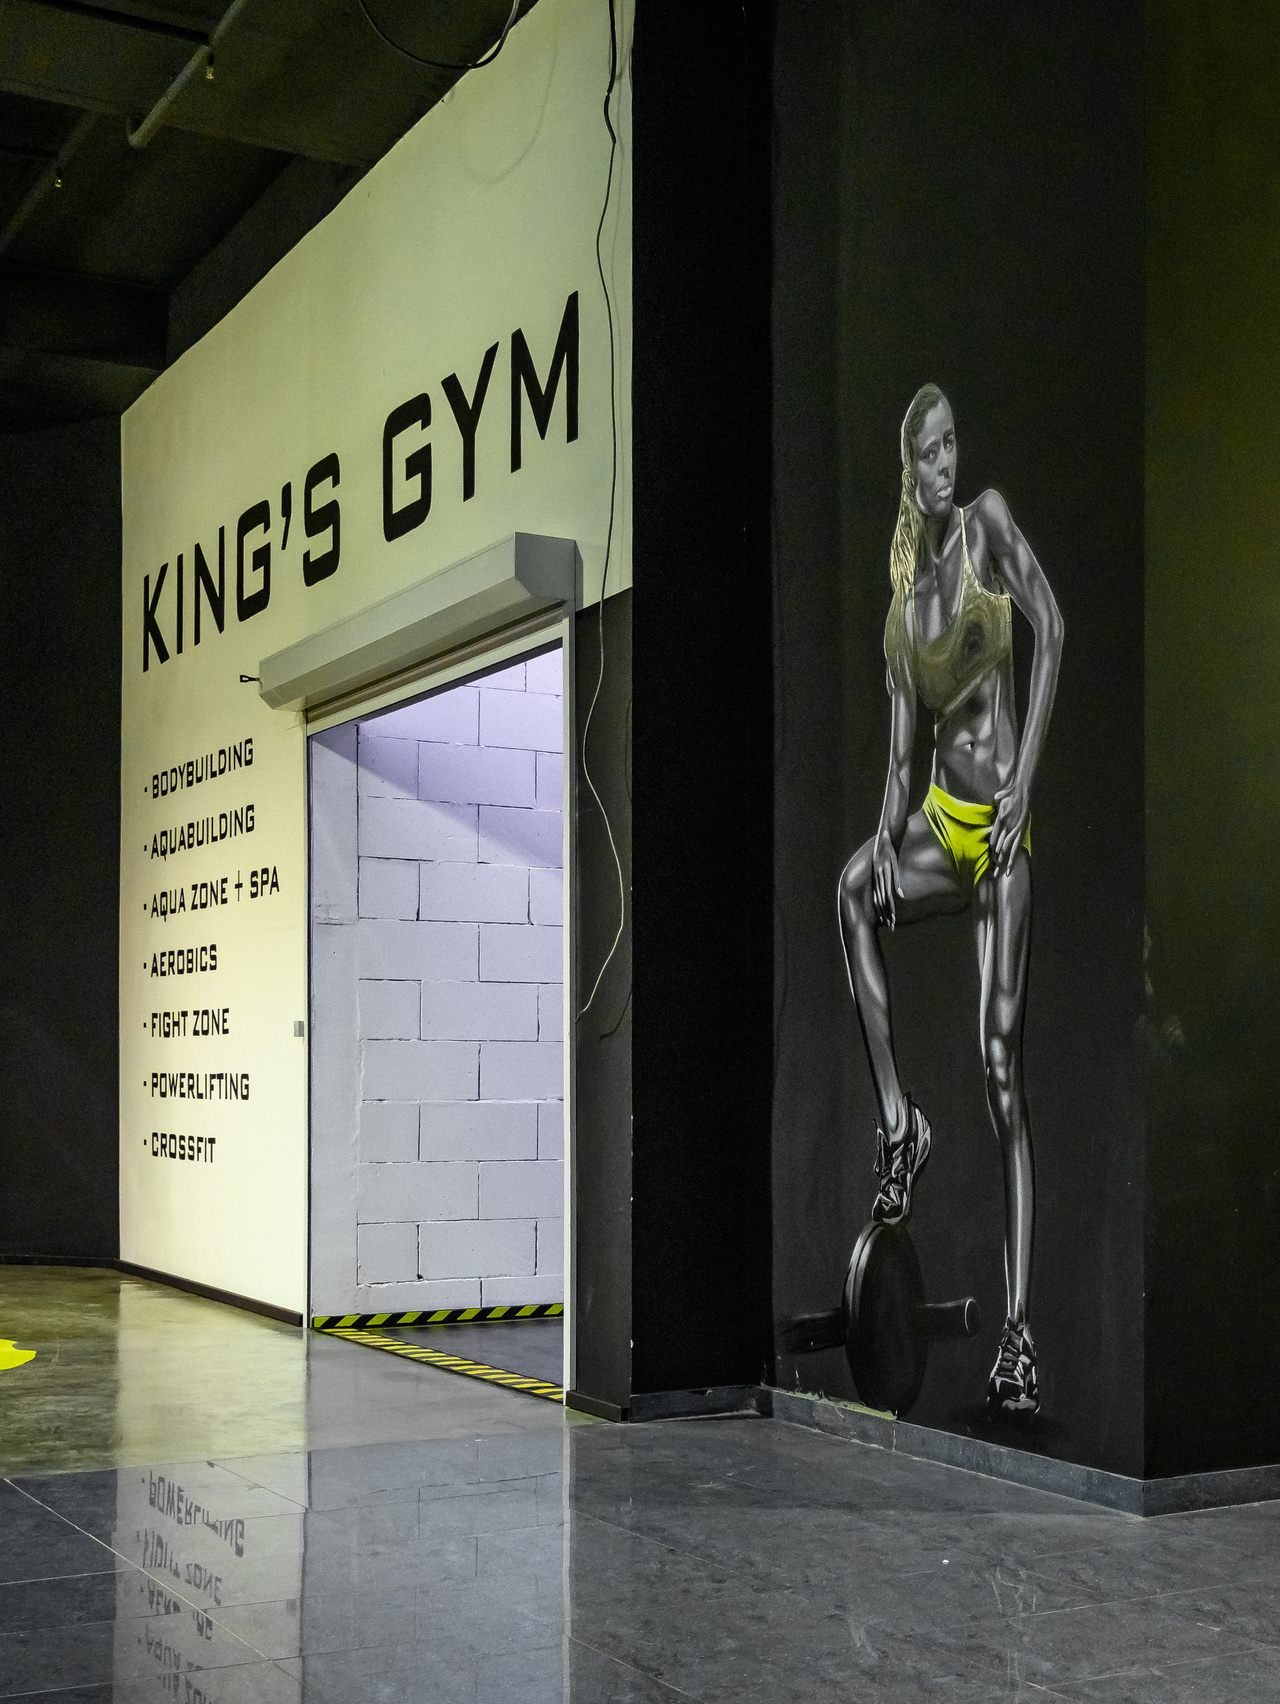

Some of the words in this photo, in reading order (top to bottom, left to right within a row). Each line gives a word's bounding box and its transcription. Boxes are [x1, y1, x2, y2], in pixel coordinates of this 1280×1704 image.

[143, 452, 341, 673] KING'S
[382, 290, 579, 543] GYM
[152, 737, 254, 799] BODYBUILDING
[151, 804, 256, 861] AQUABUILDING
[151, 890, 186, 922] AQUA
[191, 877, 229, 910] ZONE
[250, 866, 280, 899] SPA
[151, 944, 218, 978] AEROBICS
[151, 1010, 188, 1038] FIGHT
[193, 1008, 230, 1037] ZONE
[151, 1072, 250, 1100] POWERLIFTING
[151, 1132, 216, 1163] CROSSFIT
